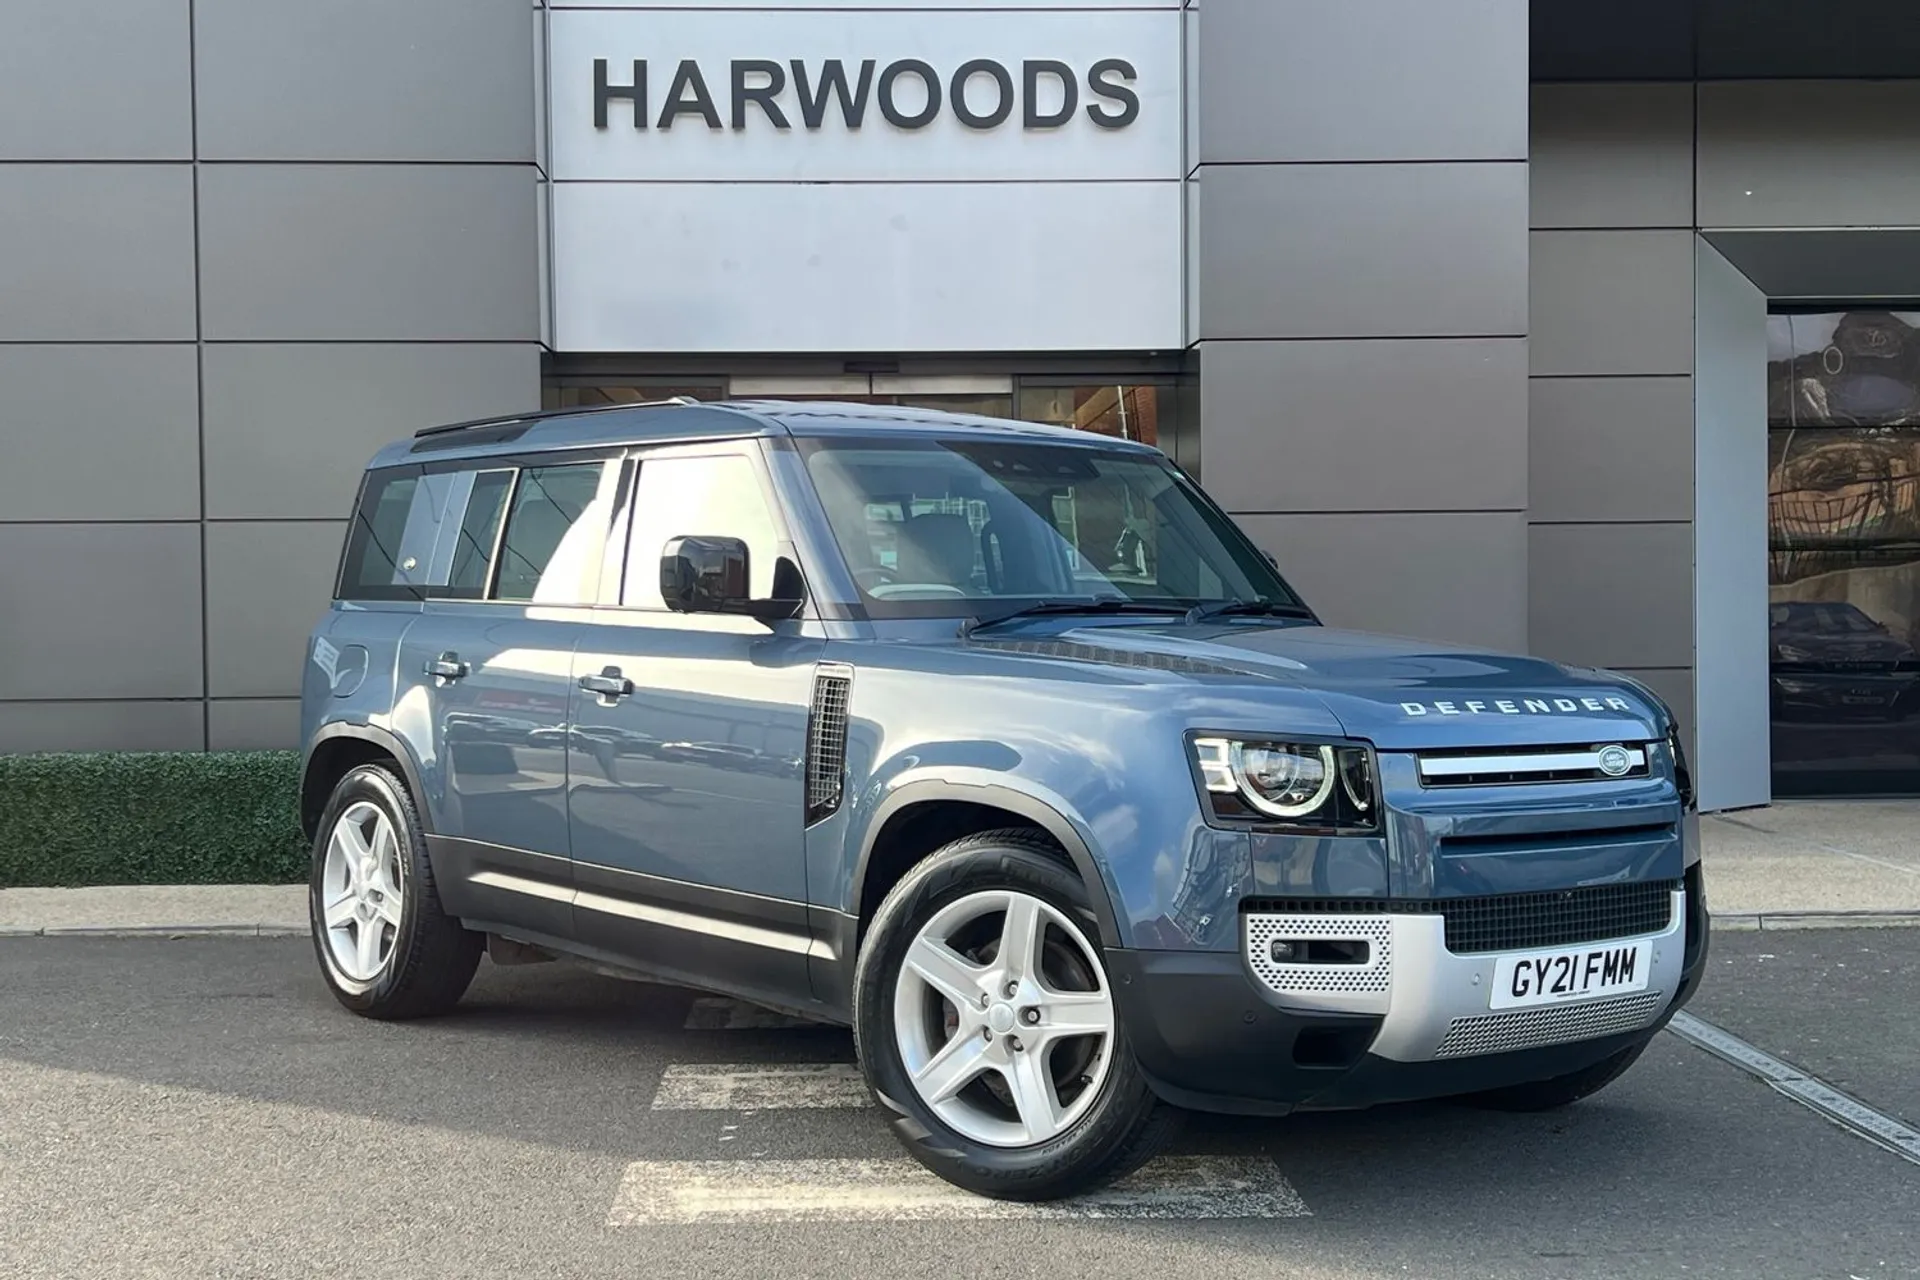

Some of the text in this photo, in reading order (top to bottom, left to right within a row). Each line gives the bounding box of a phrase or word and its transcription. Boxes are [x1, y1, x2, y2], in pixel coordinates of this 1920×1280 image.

[593, 58, 1140, 130] HARWOODS
[1400, 697, 1630, 716] DEFENDER
[1511, 947, 1637, 998] GY21 FMM
